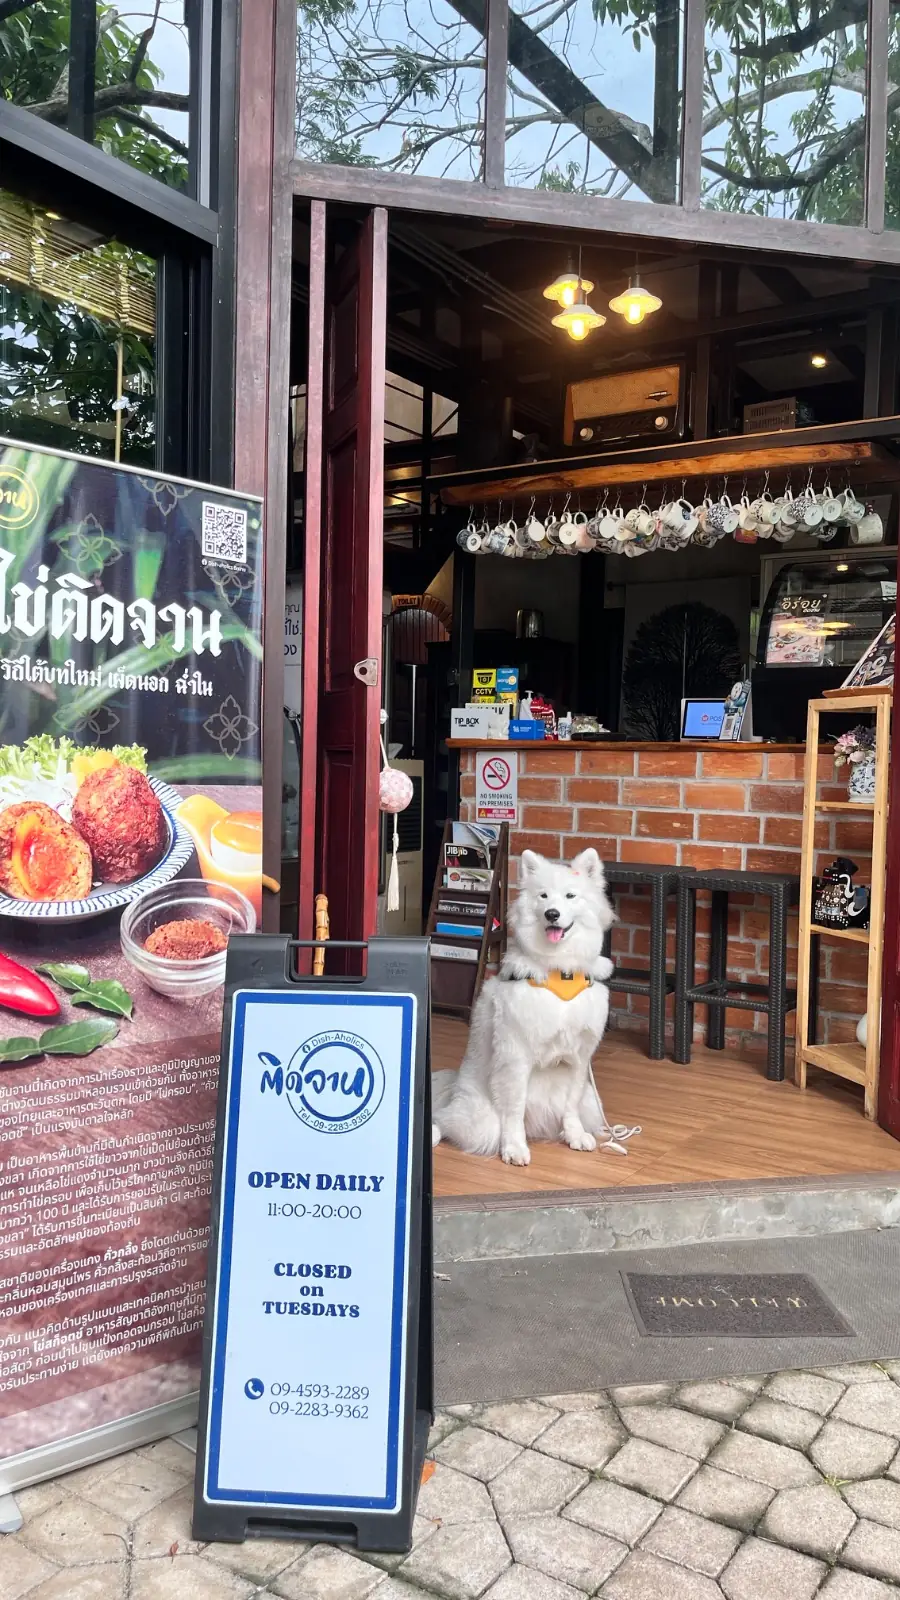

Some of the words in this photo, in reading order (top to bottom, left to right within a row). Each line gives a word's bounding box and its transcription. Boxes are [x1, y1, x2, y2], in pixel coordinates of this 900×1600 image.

[454, 717, 464, 725] TIP
[465, 717, 480, 725] BOX
[311, 1033, 365, 1050] Dish-Aholics
[257, 1051, 365, 1098] ติดจาน
[248, 1171, 311, 1190] OPEN
[315, 1173, 385, 1192] DAILY
[170, 1192, 181, 1203] GI
[37, 1207, 58, 1220] 100
[62, 1203, 69, 1216] ปี
[267, 1202, 362, 1220] 11:00-20:00
[273, 1262, 352, 1279] CLOSED
[299, 1285, 325, 1297] on
[262, 1301, 360, 1318] TUESDAYS
[270, 1382, 370, 1401] 09-4593-2289
[269, 1401, 369, 1420] 09-2283-9362
